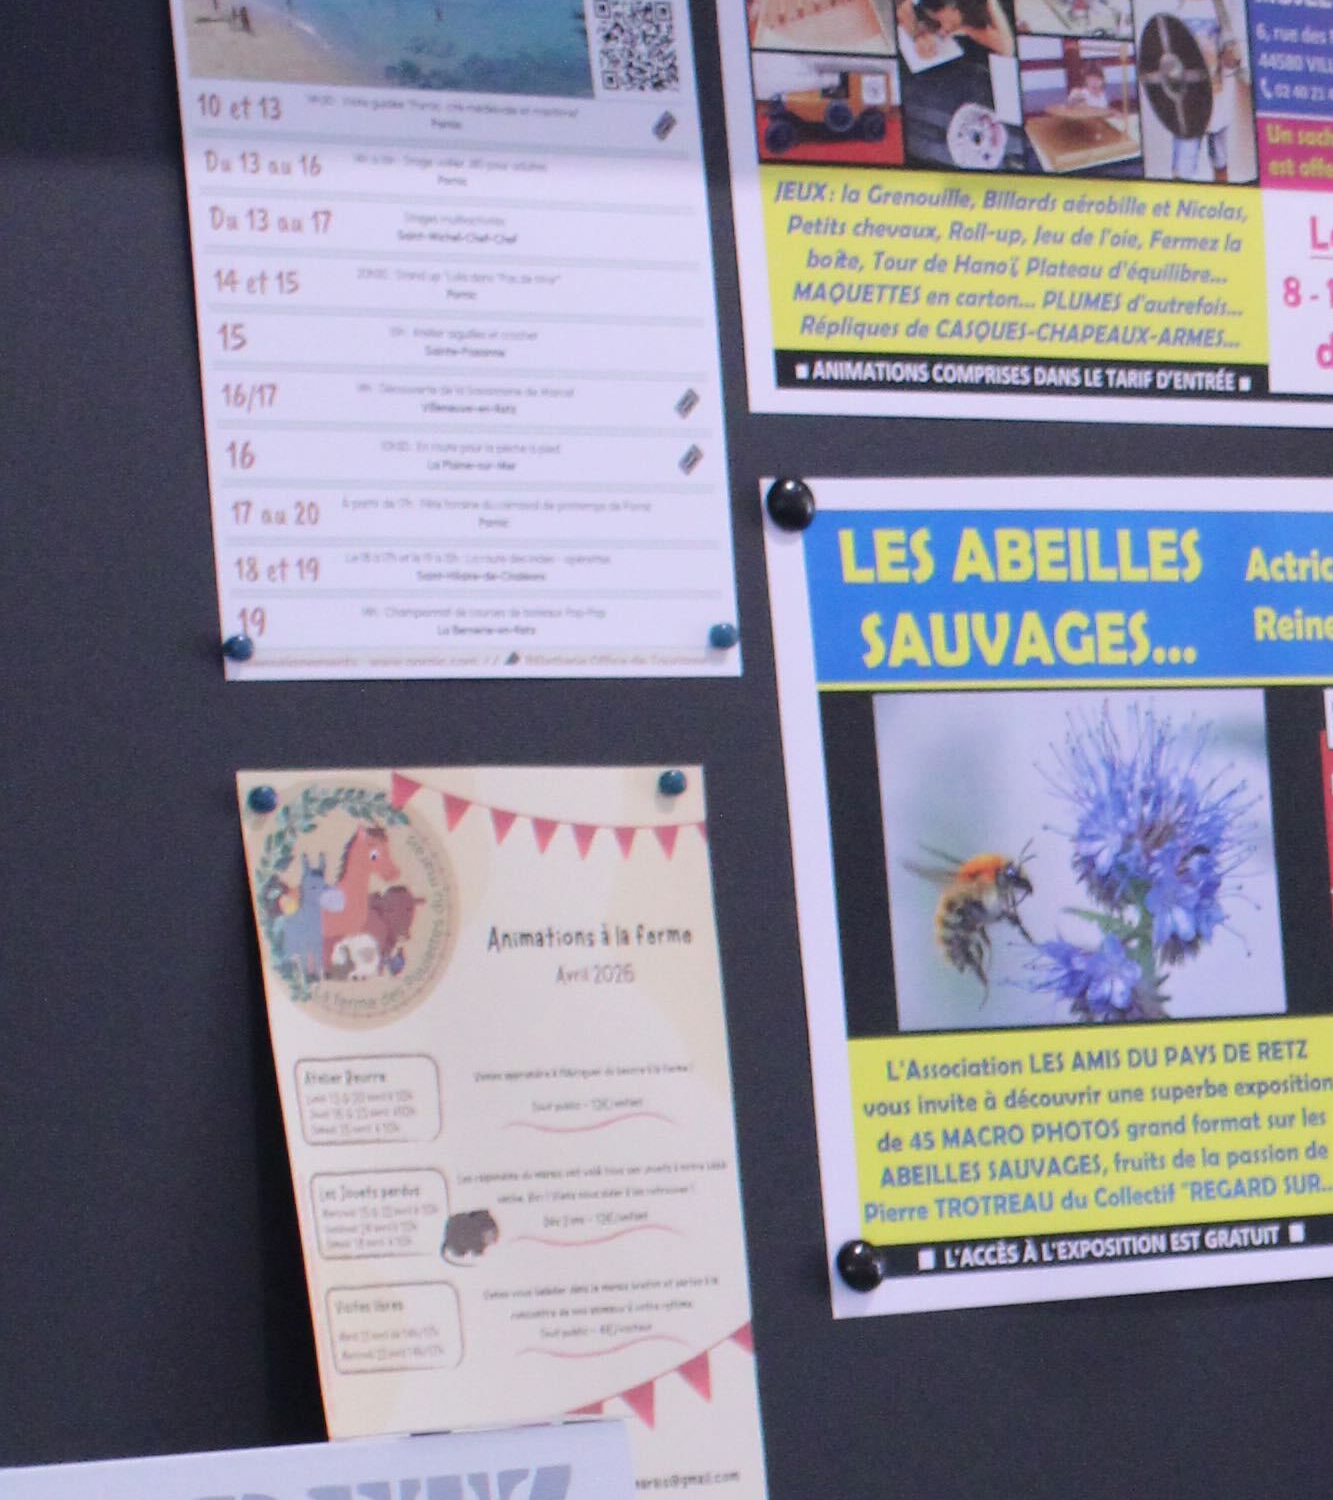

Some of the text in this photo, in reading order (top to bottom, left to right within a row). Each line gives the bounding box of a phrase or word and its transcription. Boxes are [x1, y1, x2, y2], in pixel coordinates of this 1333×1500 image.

[198, 94, 221, 119] 10
[230, 97, 251, 119] et
[259, 96, 282, 120] 13
[842, 184, 859, 205] la
[868, 185, 976, 210] Grenouille,
[983, 190, 1056, 212] Billards
[1063, 195, 1146, 217] aérobille
[1153, 200, 1171, 219] et
[1177, 200, 1248, 223] Nicolas,
[1283, 276, 1301, 308] 8
[217, 324, 247, 351] 15
[811, 359, 1235, 392] ANIMATIONS COMPRISES DANS LE TARIF D'ENTRÉE
[226, 441, 256, 470] 16
[231, 501, 252, 526] 17
[262, 509, 286, 526] au
[294, 502, 320, 526] 20
[838, 527, 1203, 584] LES ABEILLES
[861, 610, 1197, 668] SAUVAGES...
[487, 923, 691, 952] Animations à la ferme
[556, 966, 589, 984] Avril
[945, 1226, 1279, 1269] L'ACCÈS À L'EXPOSITION EST GRATUIT
